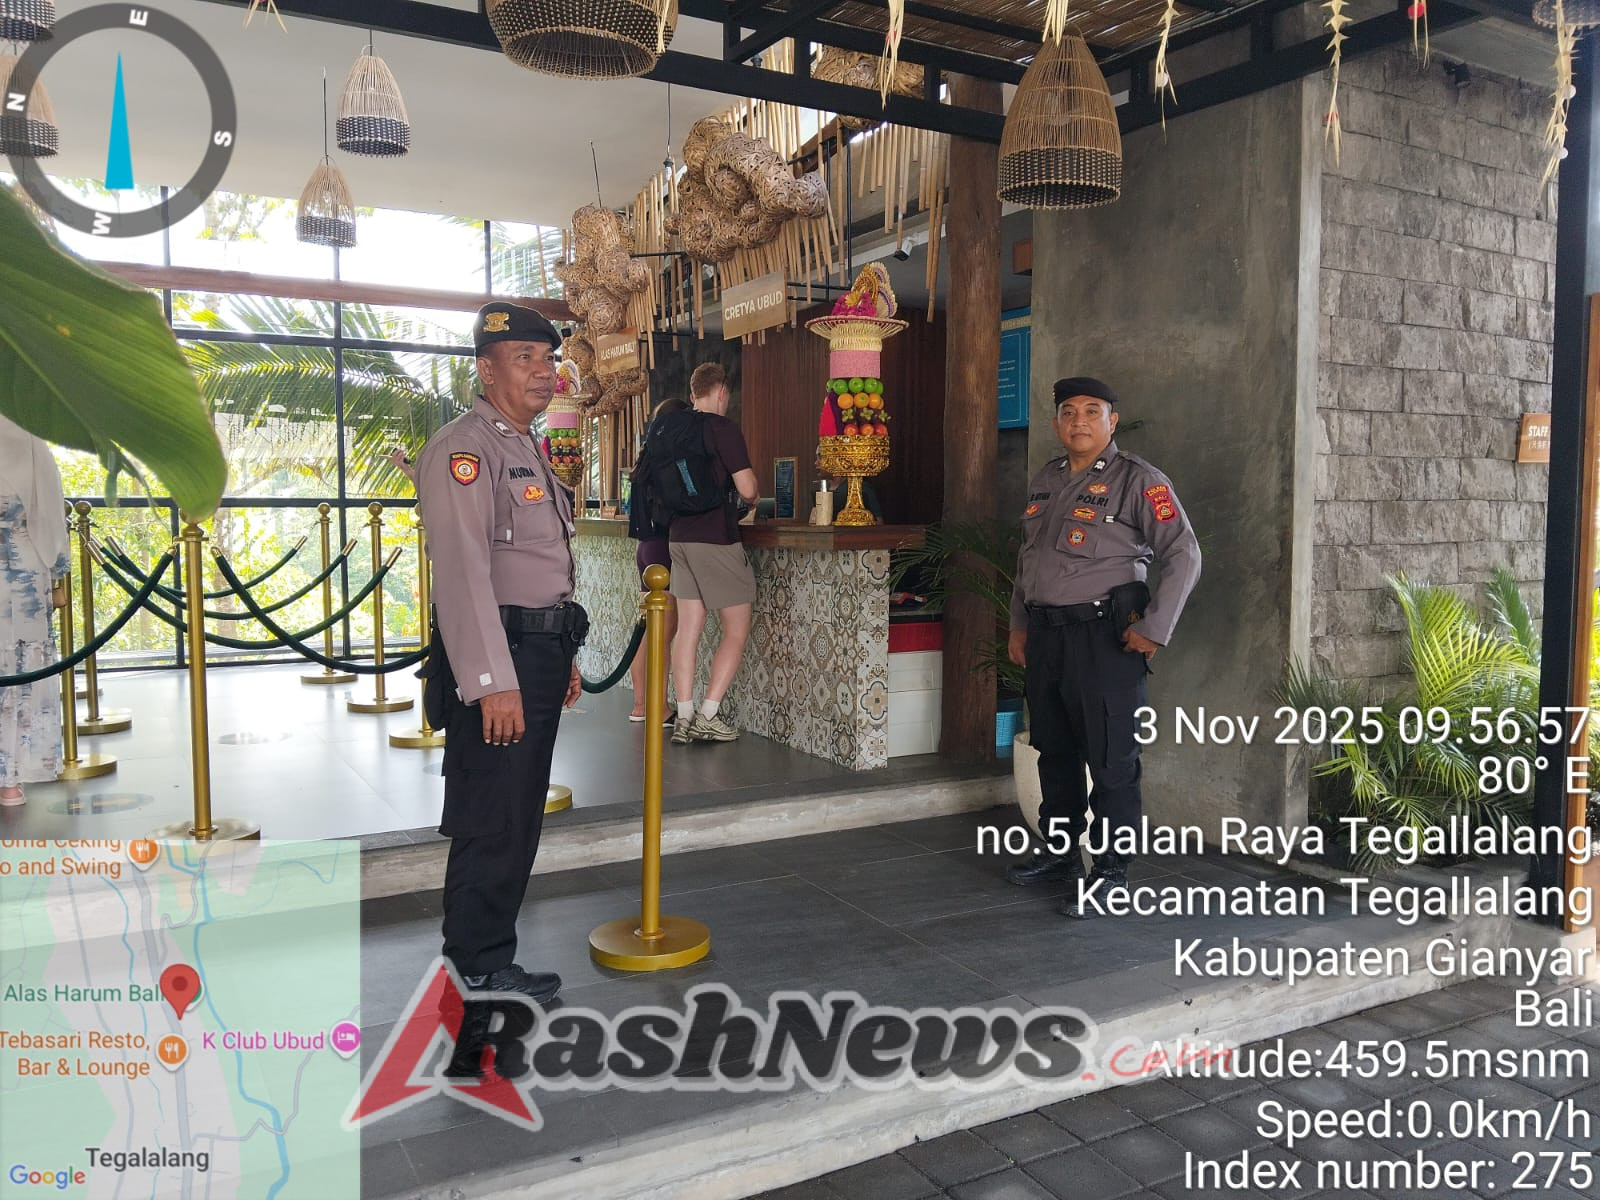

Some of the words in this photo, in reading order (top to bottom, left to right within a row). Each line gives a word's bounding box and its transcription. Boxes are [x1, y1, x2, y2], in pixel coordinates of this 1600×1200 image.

[724, 299, 756, 321] CRETYA
[757, 290, 783, 310] UBUD
[1528, 425, 1549, 437] STAFF
[1075, 494, 1109, 508] POLRI
